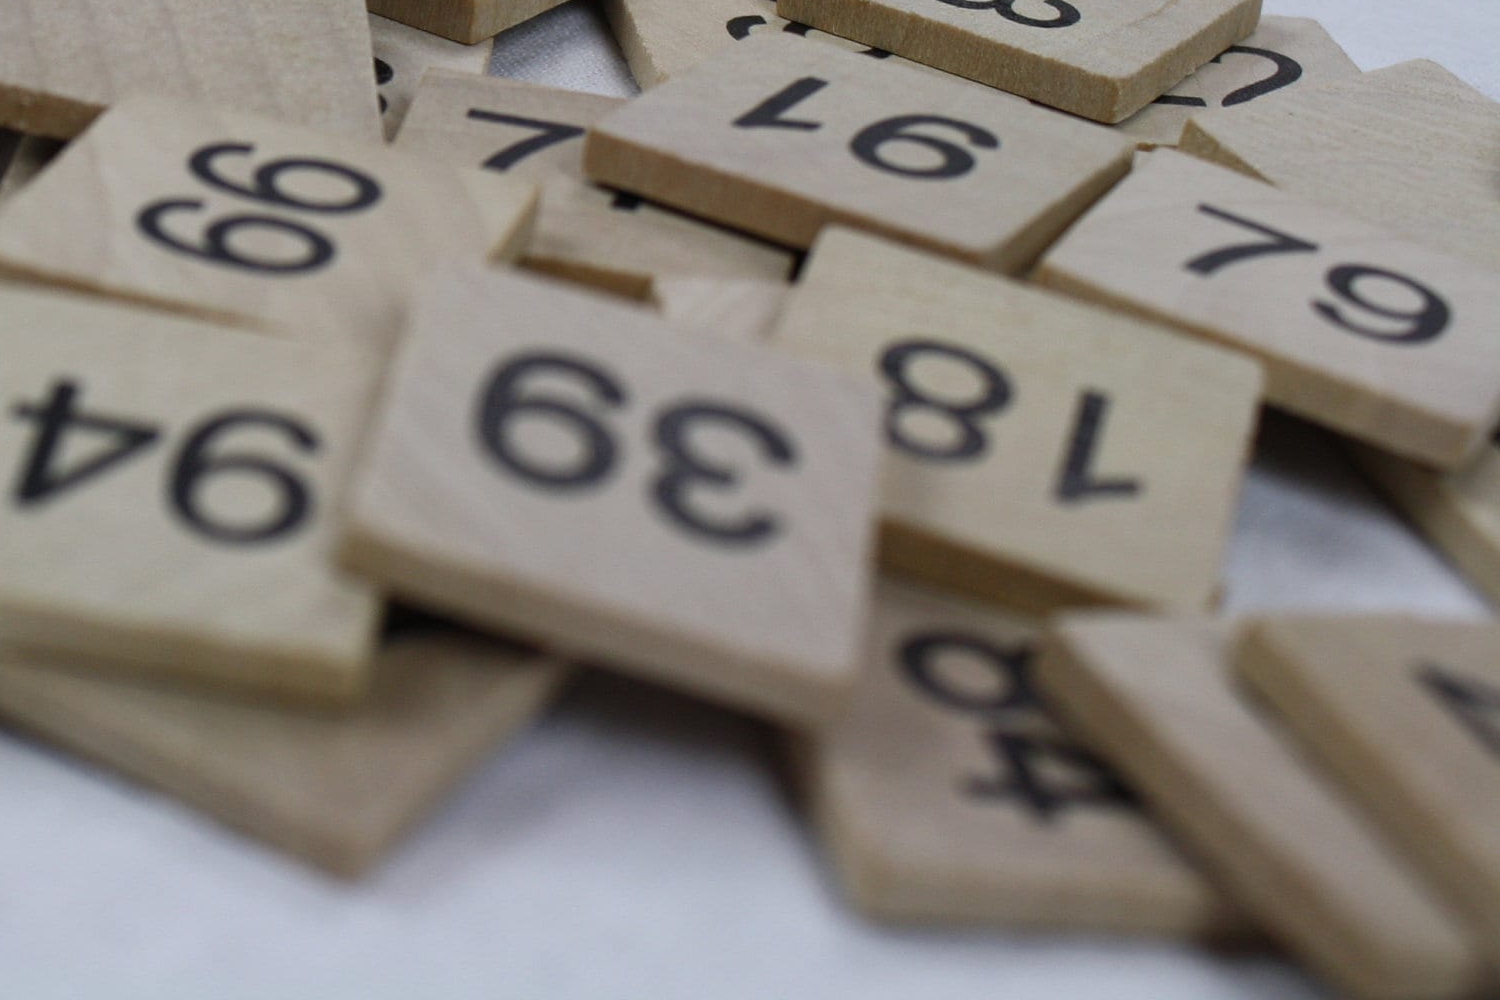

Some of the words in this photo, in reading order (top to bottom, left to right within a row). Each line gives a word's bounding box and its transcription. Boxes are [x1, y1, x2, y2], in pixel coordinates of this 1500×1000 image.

[467, 107, 586, 172] 7
[1182, 204, 1452, 346] 79
[8, 377, 322, 546] 94
[472, 350, 800, 550] 39
[877, 337, 1145, 504] 18
